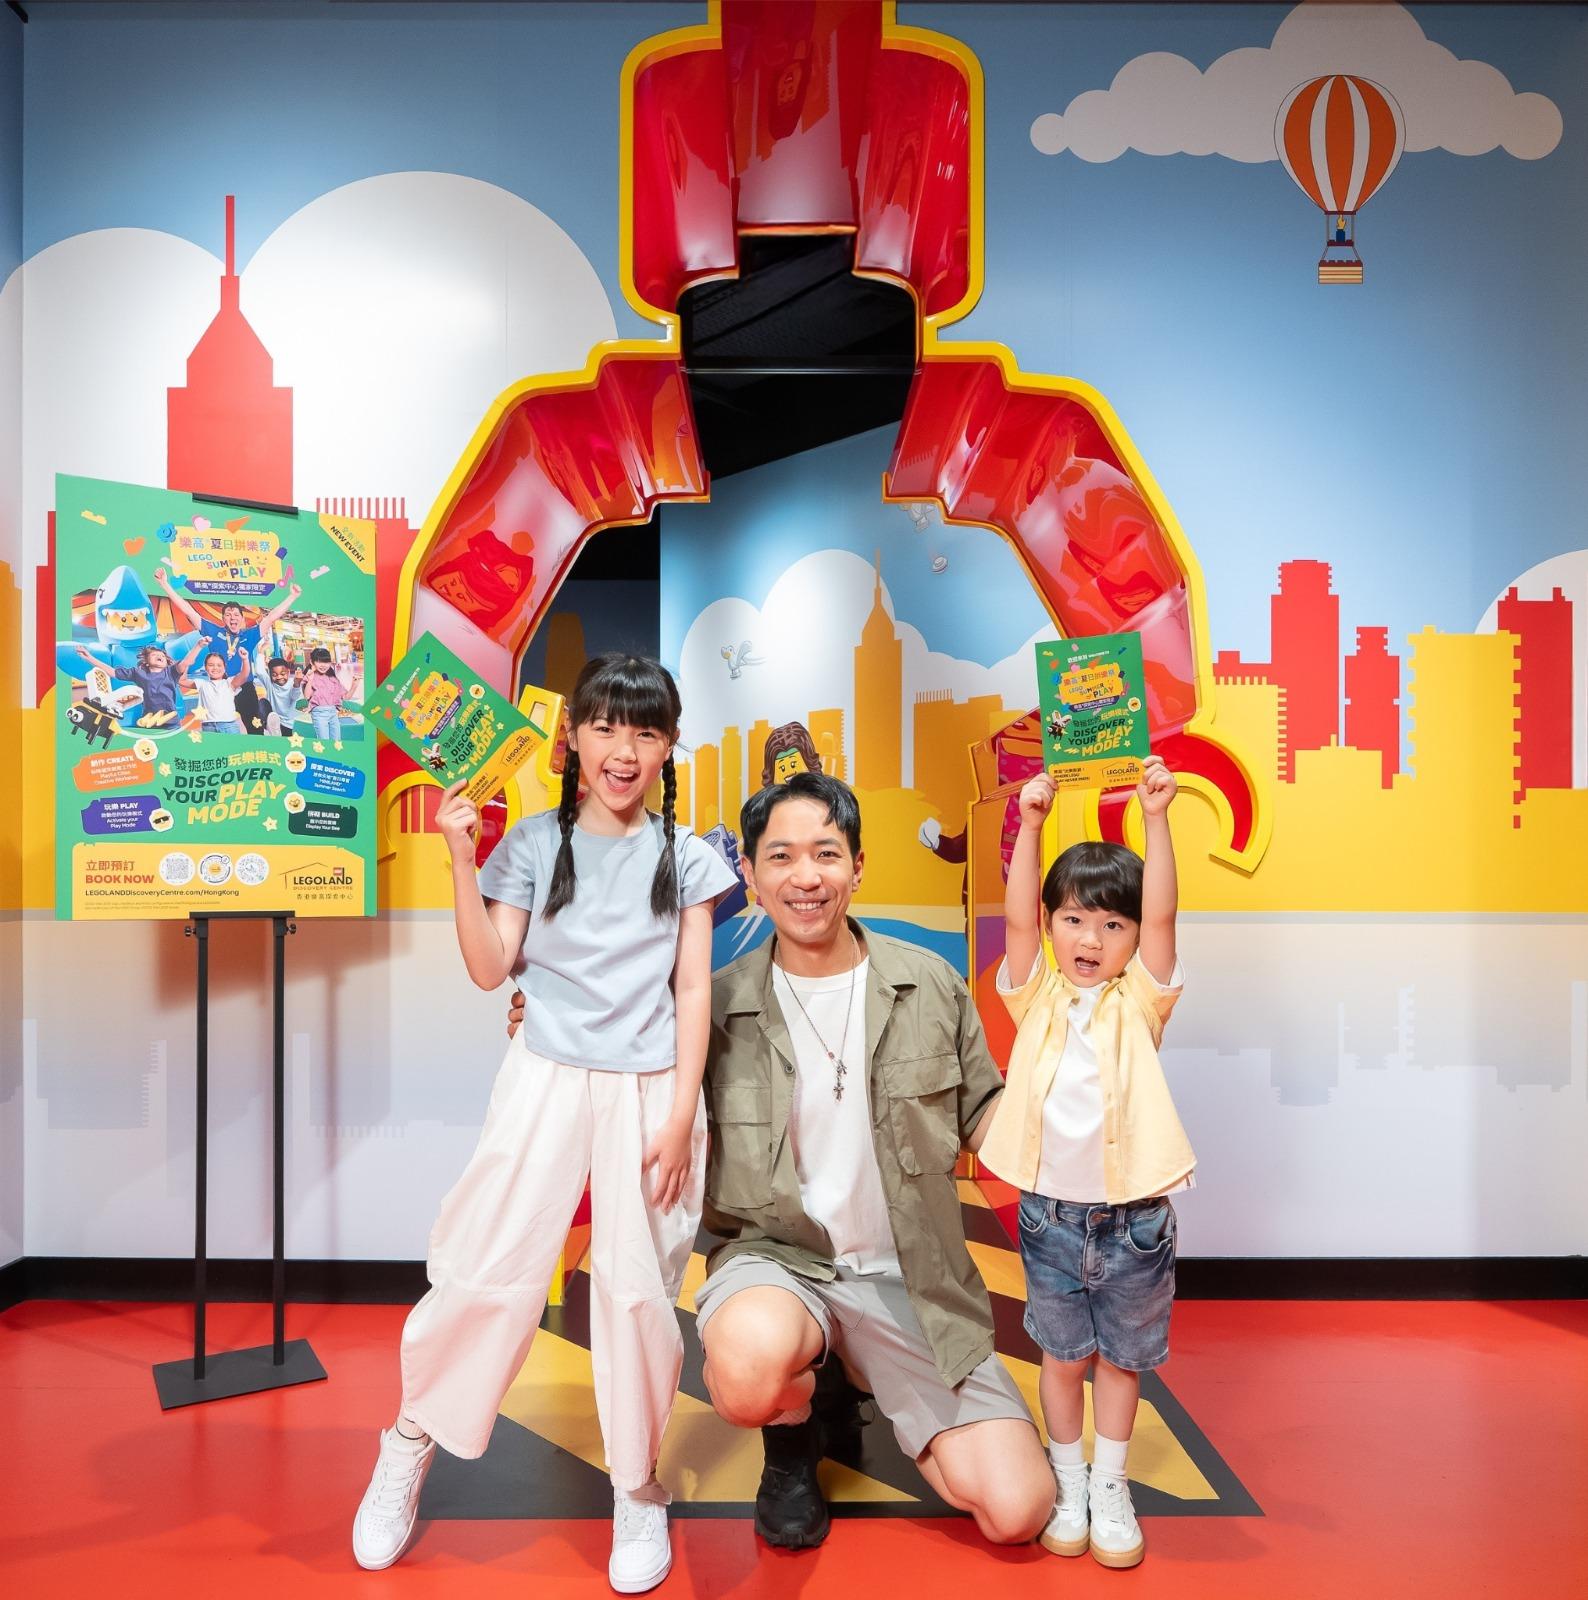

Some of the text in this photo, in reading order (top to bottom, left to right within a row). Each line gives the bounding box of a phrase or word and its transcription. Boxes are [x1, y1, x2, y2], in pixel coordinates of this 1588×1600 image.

[330, 525, 366, 562] NEW EVENT
[187, 553, 213, 562] LEGO
[206, 558, 250, 570] SUMMER
[229, 566, 266, 579] PLAY
[1093, 686, 1114, 698] PLAY
[436, 691, 452, 714] PLAY
[450, 709, 485, 757] DISCOVER
[1068, 725, 1134, 746] YOUR PLAY
[1073, 718, 1126, 738] DISCOVER
[452, 741, 475, 766] YOUR
[469, 709, 495, 745] PLAY
[468, 726, 497, 766] MODE
[505, 735, 530, 763] LEGOLAND
[1081, 736, 1122, 757] MODE
[106, 755, 135, 765] CREATE
[324, 766, 355, 778] DISCOVER
[1106, 764, 1140, 776] LEGOLAND
[174, 768, 273, 789] DISCOVER
[163, 780, 287, 804] YOUR PLAY
[119, 802, 139, 810] PLAY
[187, 798, 263, 825] MODE
[321, 811, 341, 819] BUILD
[85, 859, 135, 872] 立即預訂
[85, 874, 155, 884] BOOK NOW
[293, 870, 353, 885] LEGOLAND
[85, 889, 240, 897] LEGOLANDDiscoveryCentre.com/HongKong
